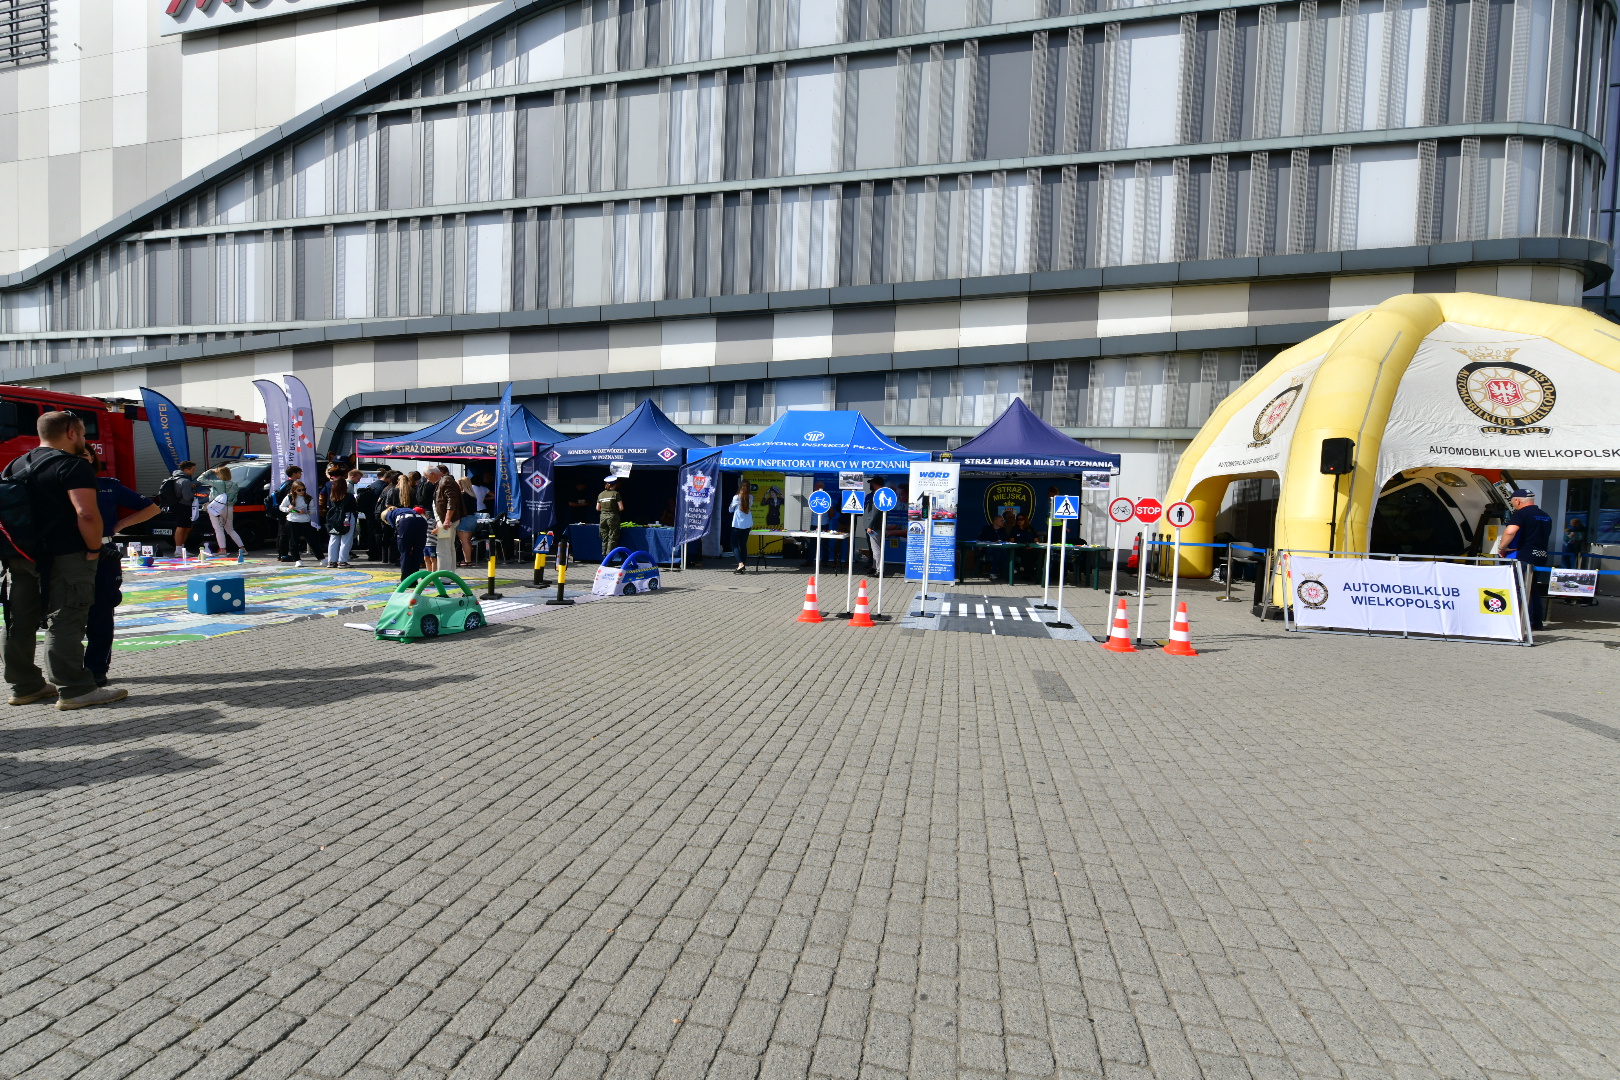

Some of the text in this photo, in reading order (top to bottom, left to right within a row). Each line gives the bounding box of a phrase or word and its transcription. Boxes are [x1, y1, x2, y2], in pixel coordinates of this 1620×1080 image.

[1458, 368, 1555, 426] AUTOMOBILKLUB WIELKOPOLSKI
[396, 443, 419, 453] STRAŻ
[420, 445, 457, 454] OCHRONY
[1429, 446, 1620, 457] AUTOMOBILKLUB WIELKOPOLSK
[758, 459, 815, 468] INSPEKTORAT
[818, 460, 846, 469] PRACY
[862, 461, 910, 469] POZNANIU
[502, 482, 514, 512] STRAŻ
[993, 493, 1026, 501] MIEJSKA
[1136, 506, 1161, 515] STOP
[1342, 582, 1460, 597] AUTOMOBILKLUB
[1351, 595, 1455, 610] WIELKOPOLSKI
